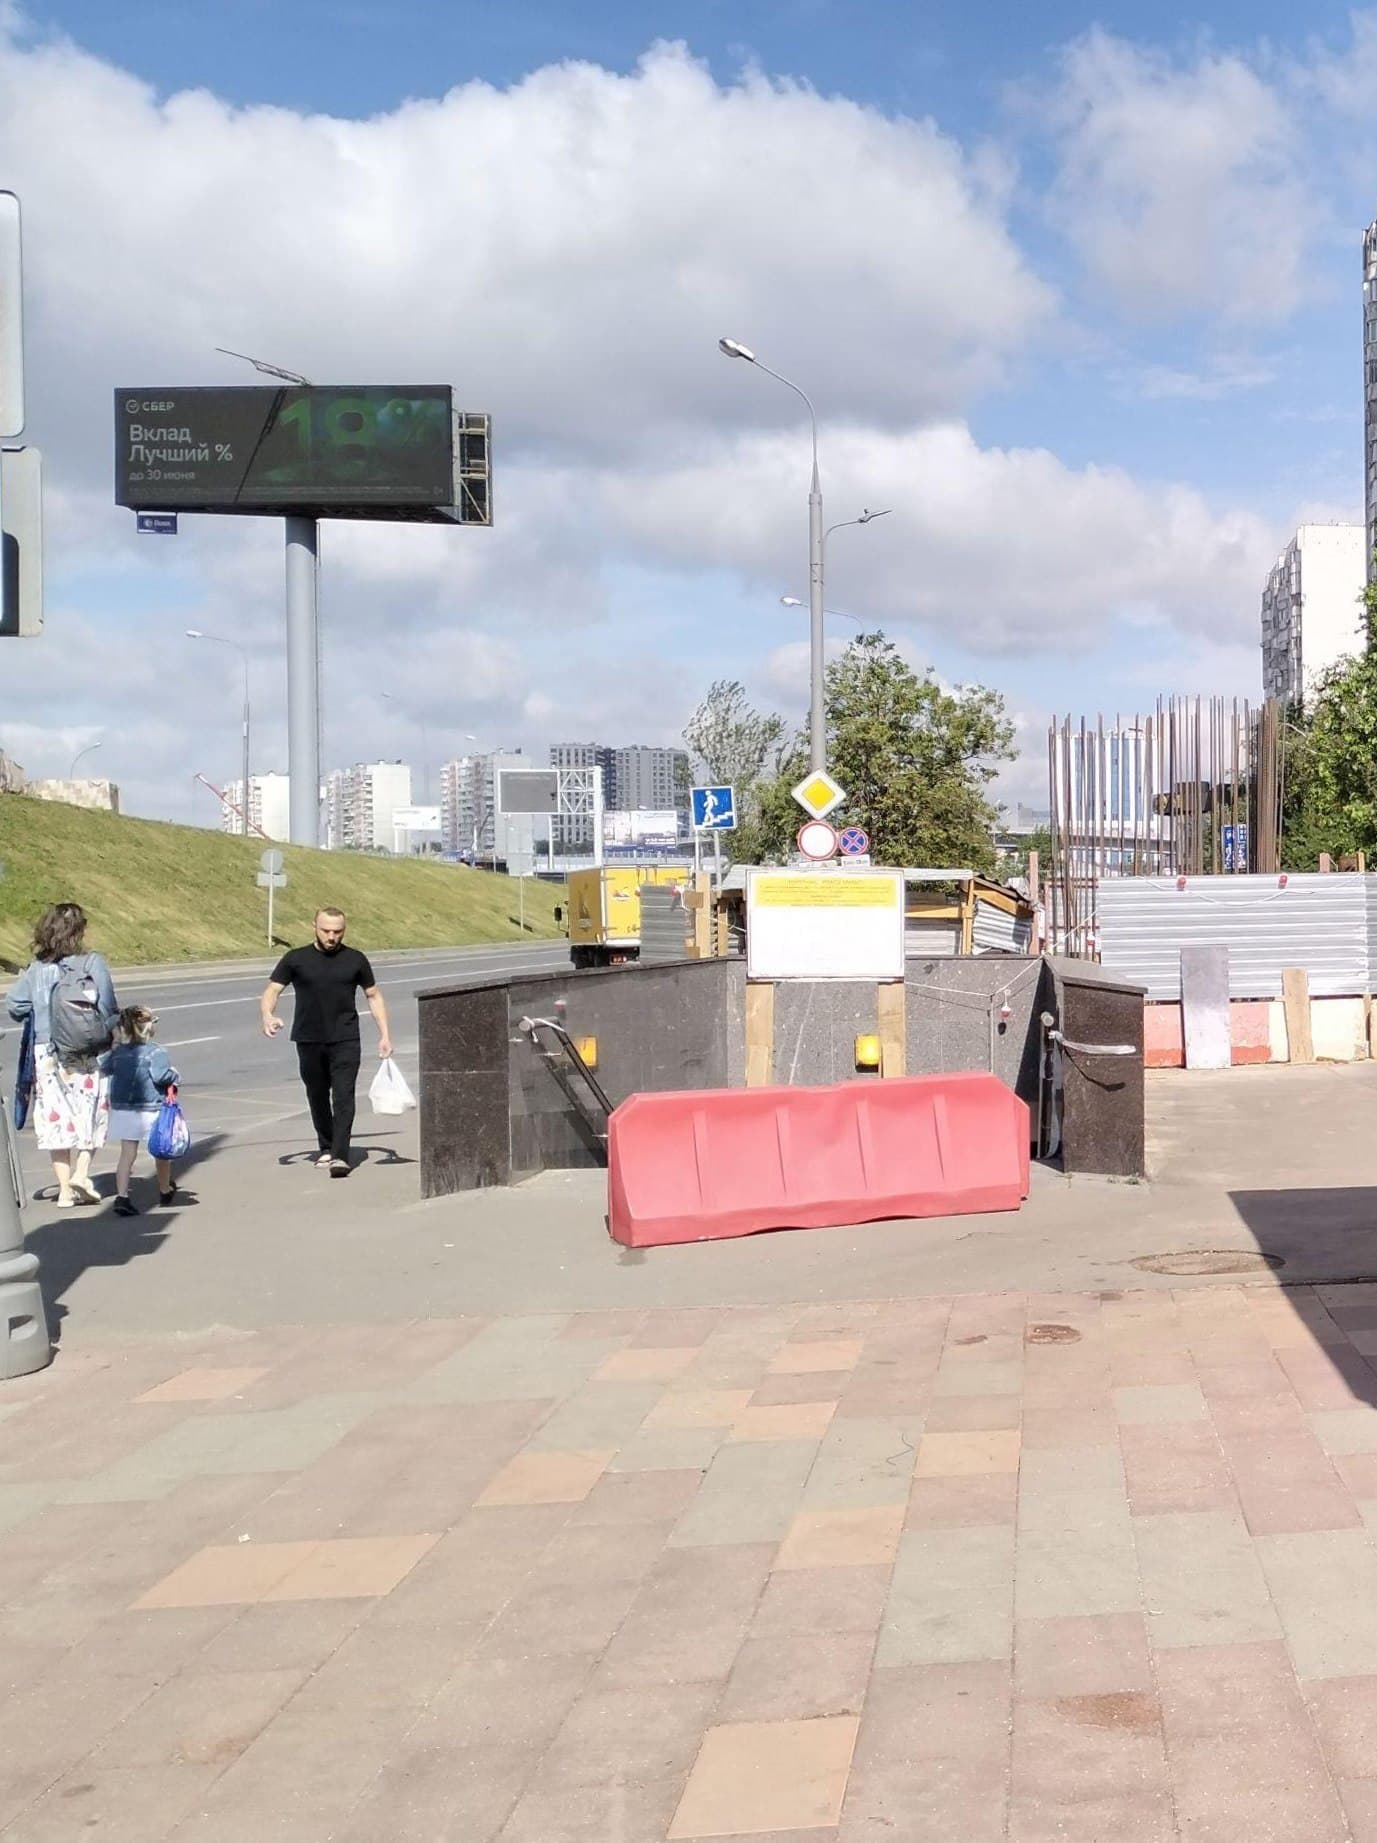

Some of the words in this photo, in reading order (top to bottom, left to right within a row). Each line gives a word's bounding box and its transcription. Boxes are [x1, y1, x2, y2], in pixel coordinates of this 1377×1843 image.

[142, 401, 175, 411] СБЕР
[129, 424, 192, 443] Вклад
[128, 442, 209, 465] Лучший
[215, 443, 233, 462] %
[129, 471, 144, 480] до
[147, 469, 162, 480] 30
